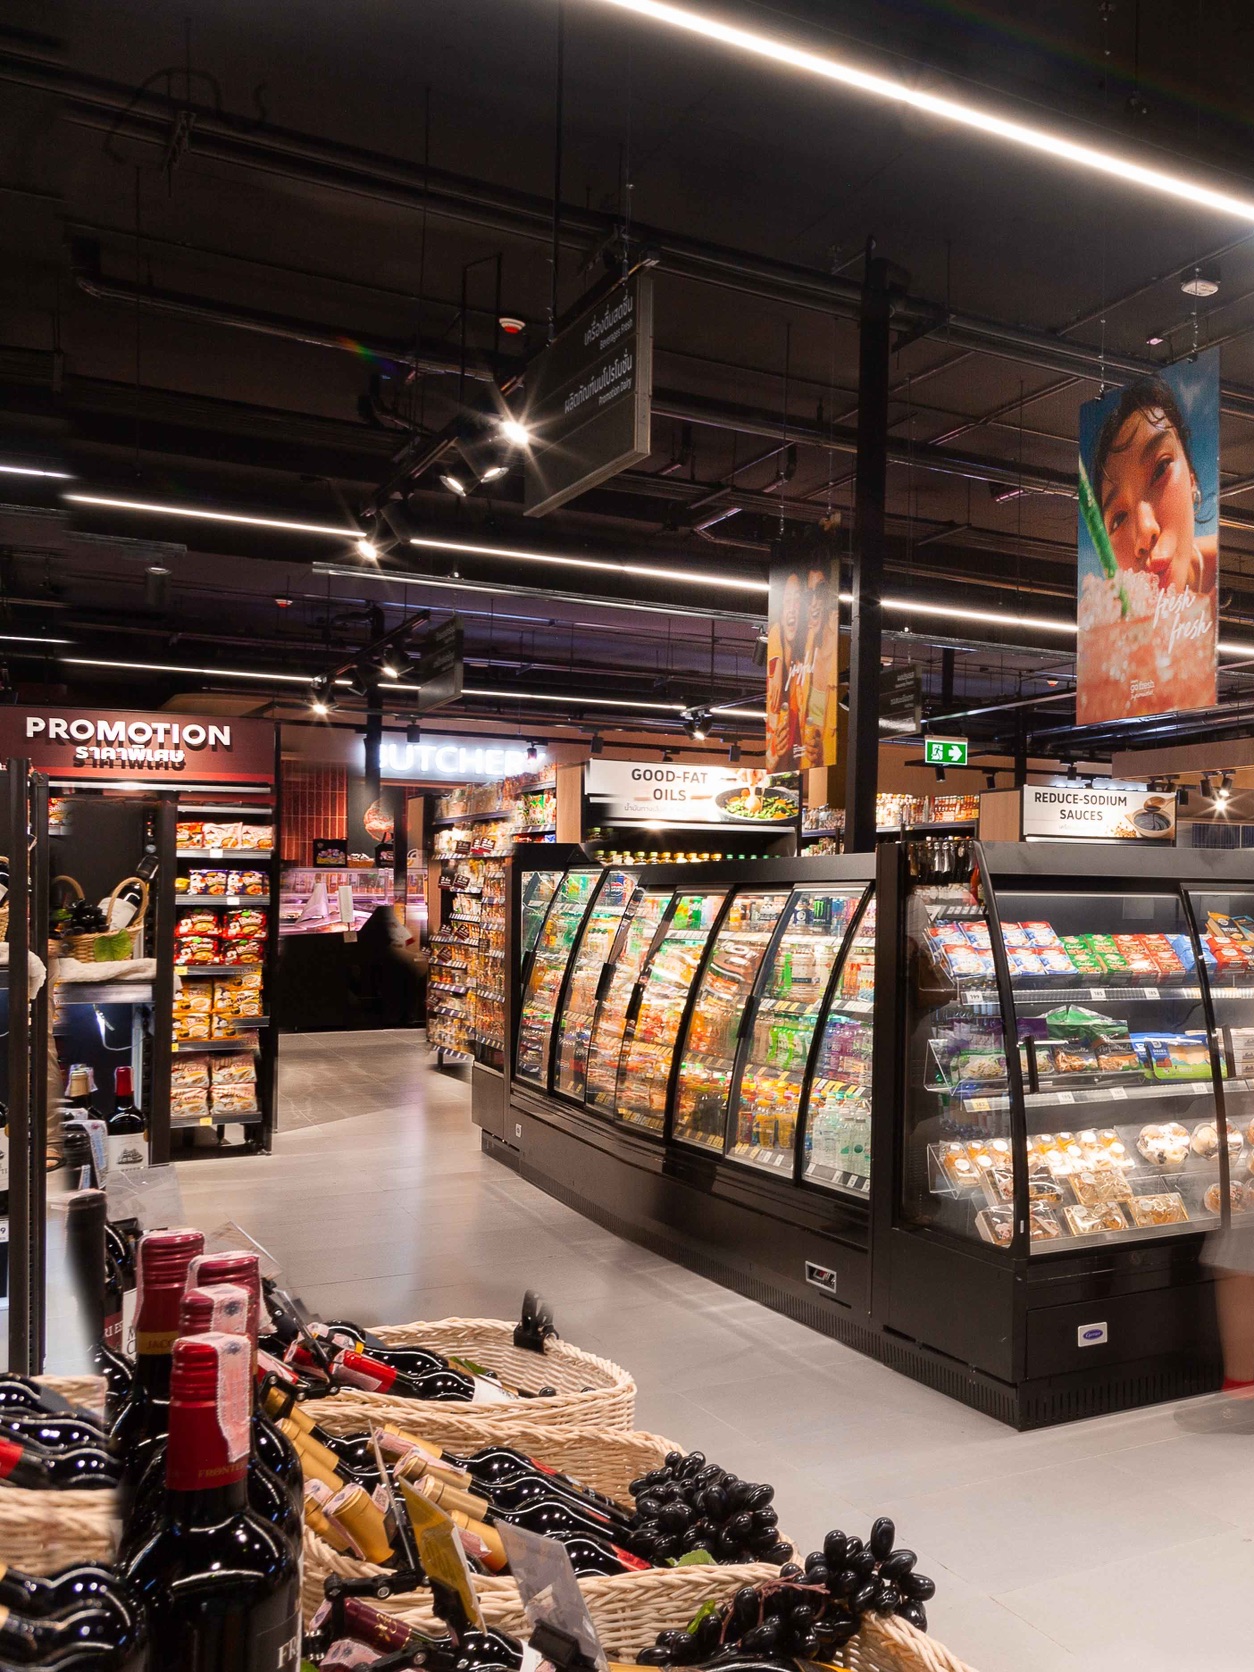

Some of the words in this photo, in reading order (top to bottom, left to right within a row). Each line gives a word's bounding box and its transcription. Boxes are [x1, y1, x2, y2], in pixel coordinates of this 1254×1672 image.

[1152, 584, 1196, 629] fresh
[1167, 610, 1213, 655] fresh
[26, 716, 231, 747] PROMOTION
[75, 743, 186, 764] ราคาพิเศษ
[631, 768, 708, 785] GOOD-FAT
[653, 788, 687, 802] OILS
[1034, 791, 1128, 807] REDUCE-SODIUM
[1059, 808, 1104, 821] SAUCES
